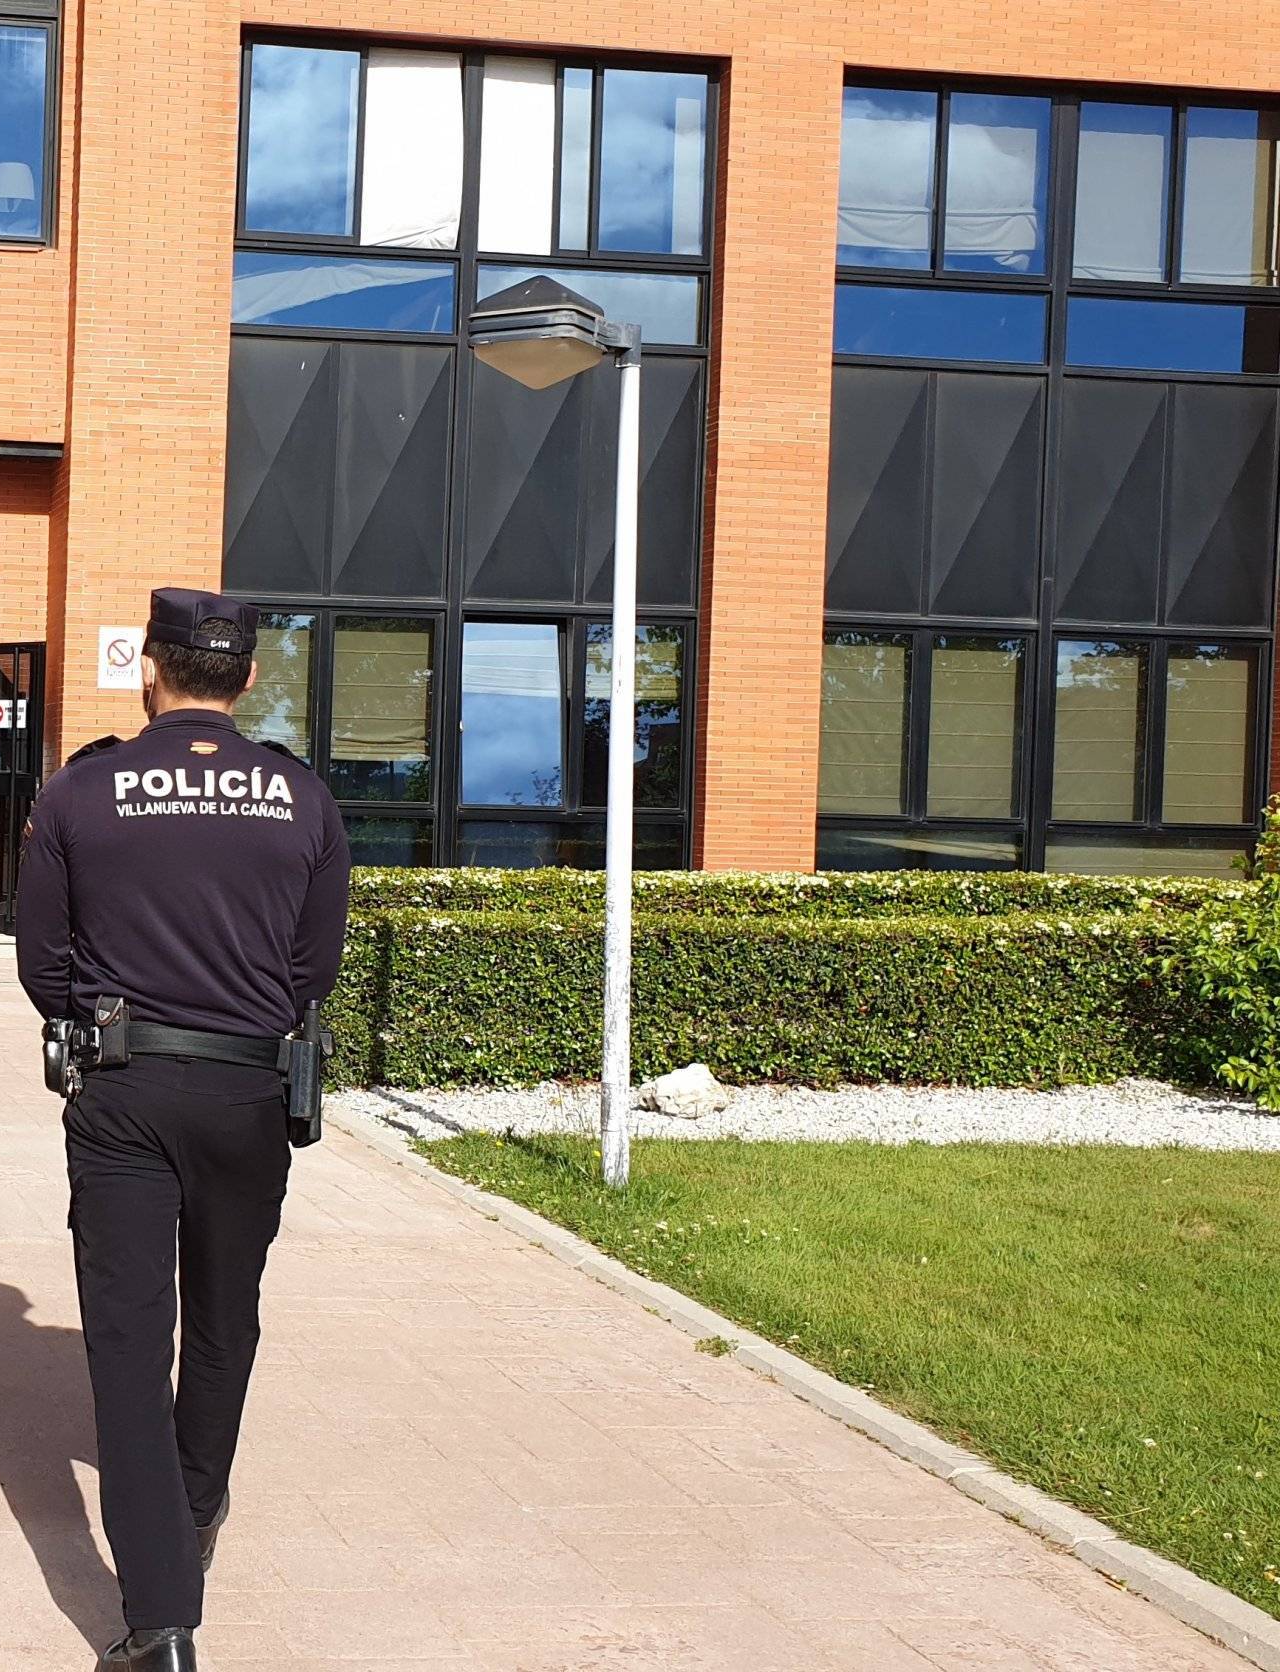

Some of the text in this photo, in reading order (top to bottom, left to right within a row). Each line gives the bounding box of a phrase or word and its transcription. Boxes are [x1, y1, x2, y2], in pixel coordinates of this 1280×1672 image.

[114, 766, 293, 804] POLICÍA
[116, 801, 294, 822] VILLANUEVA DE LA CAÑADA
